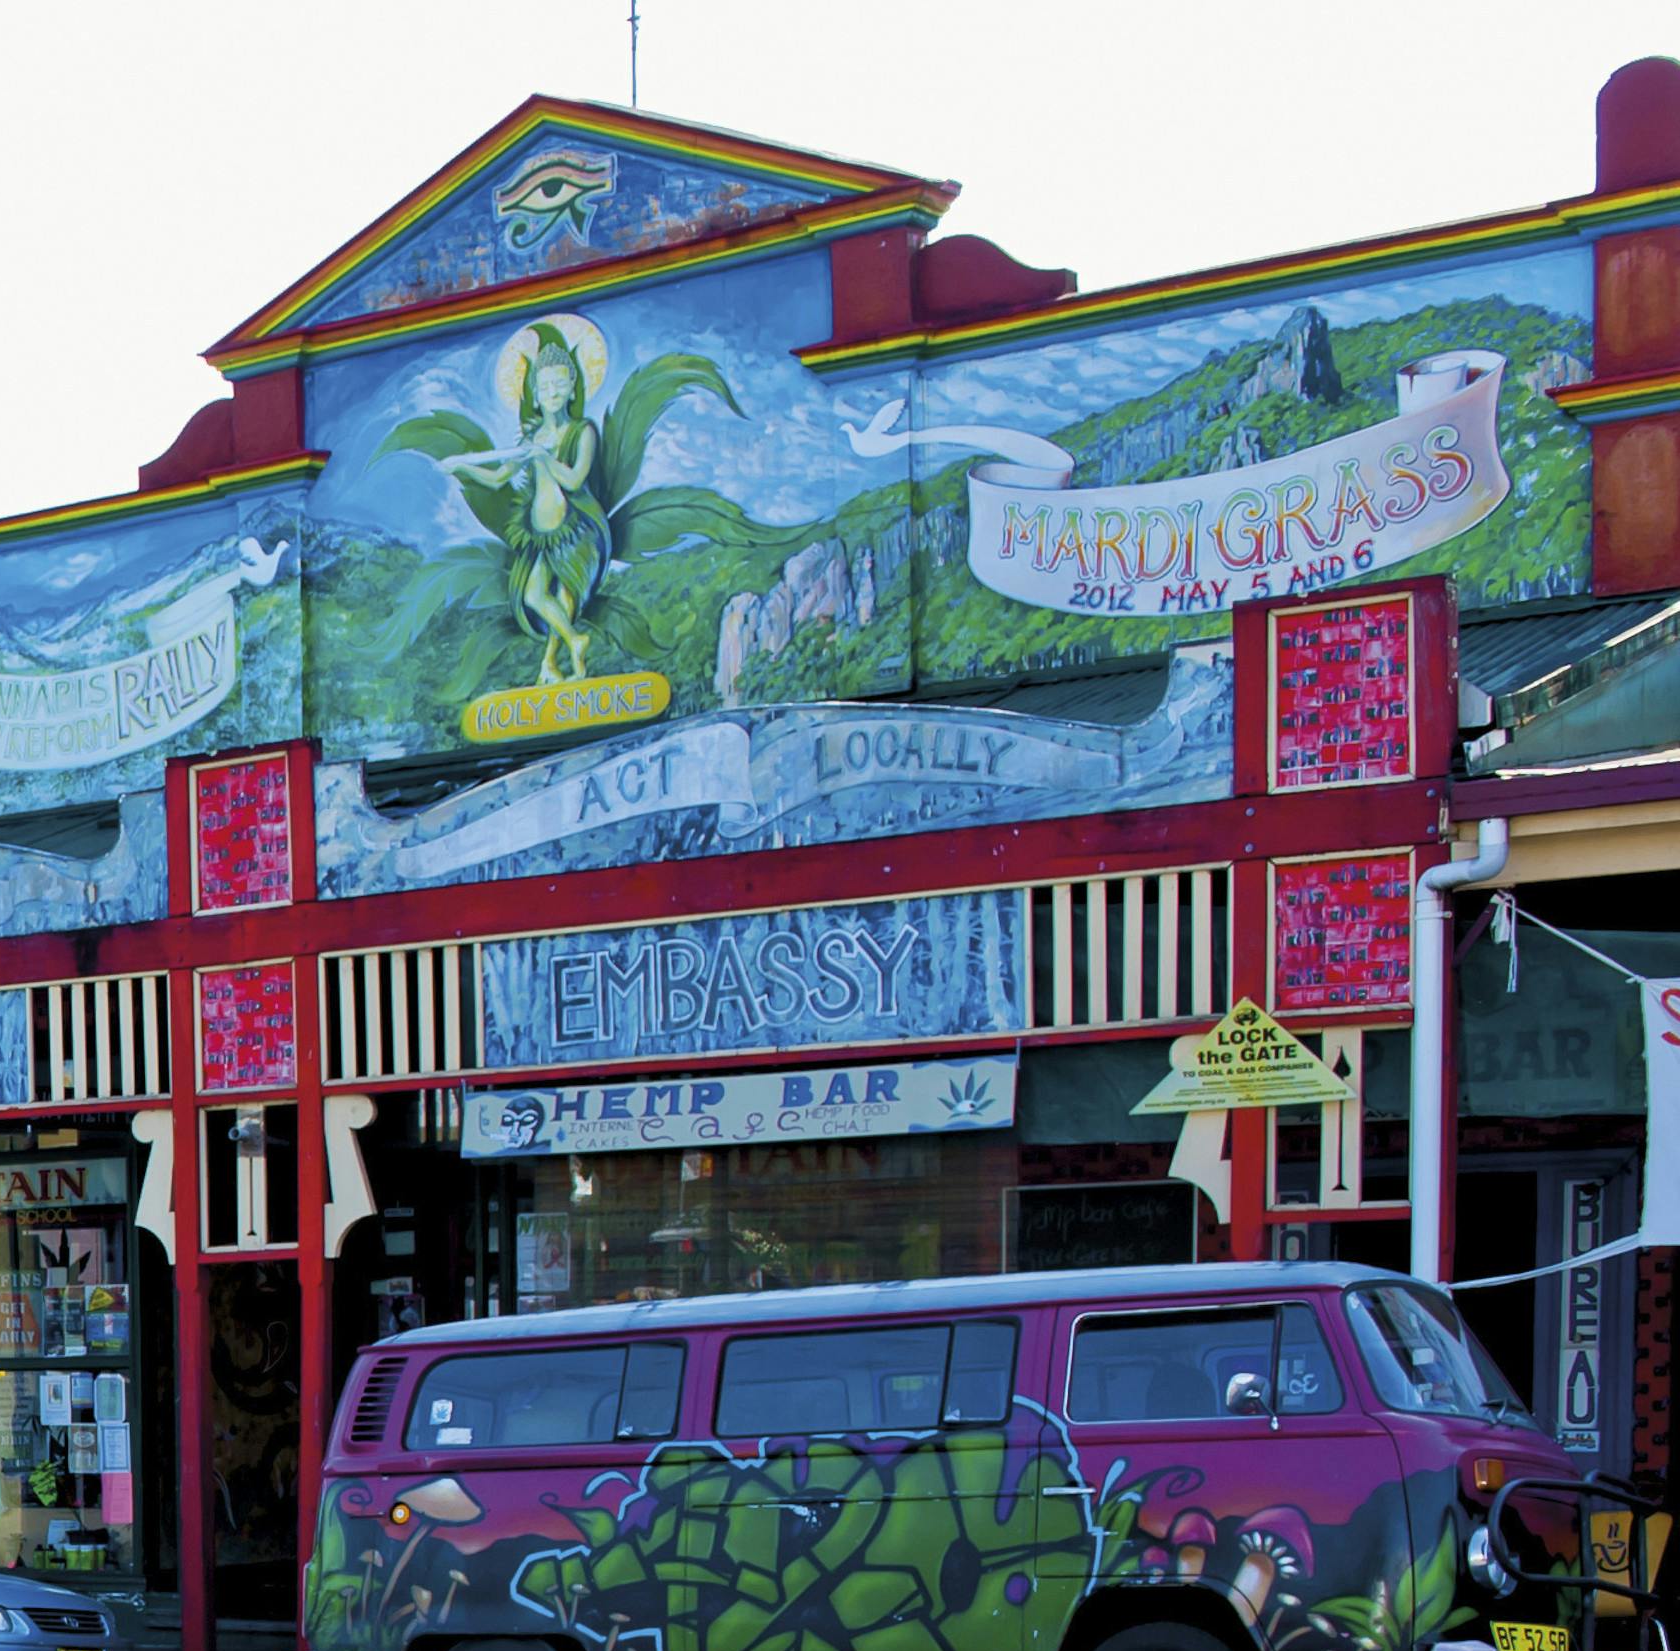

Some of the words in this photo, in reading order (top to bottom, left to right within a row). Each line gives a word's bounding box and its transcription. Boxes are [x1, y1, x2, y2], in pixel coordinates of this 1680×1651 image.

[999, 500, 1201, 582] MARDI
[1208, 422, 1475, 574] GRASS
[1068, 580, 1136, 611] 2012
[1159, 575, 1232, 613] MAY
[1250, 571, 1271, 600] 5
[1287, 553, 1345, 596] AND
[1351, 537, 1376, 572] 6
[113, 619, 228, 741] RALLY
[4, 706, 121, 763] REFORM
[474, 692, 547, 737] HOLY
[554, 680, 656, 723] SMOKE
[575, 744, 685, 826] ACT
[813, 722, 1017, 779] LOCALLY
[549, 923, 920, 1049] EMBASSY
[1197, 1050, 1233, 1065] the
[1240, 1044, 1298, 1062] GATE
[1217, 1027, 1278, 1046] LOCK
[1467, 1028, 1593, 1084] BAR
[550, 1082, 726, 1122] HEMP
[779, 1069, 902, 1107] BAR
[1198, 1069, 1224, 1078] COAL
[1236, 1066, 1256, 1074] GAS
[1258, 1062, 1314, 1073] COMPANIES
[804, 1106, 845, 1122] HEMP
[852, 1103, 891, 1117] FOOD
[822, 1118, 872, 1135] CHAI
[575, 1136, 631, 1150] CAKES
[16, 1208, 77, 1225] SCHOOL
[1565, 1184, 1599, 1424] BUREAU
[1497, 1627, 1518, 1651] BF
